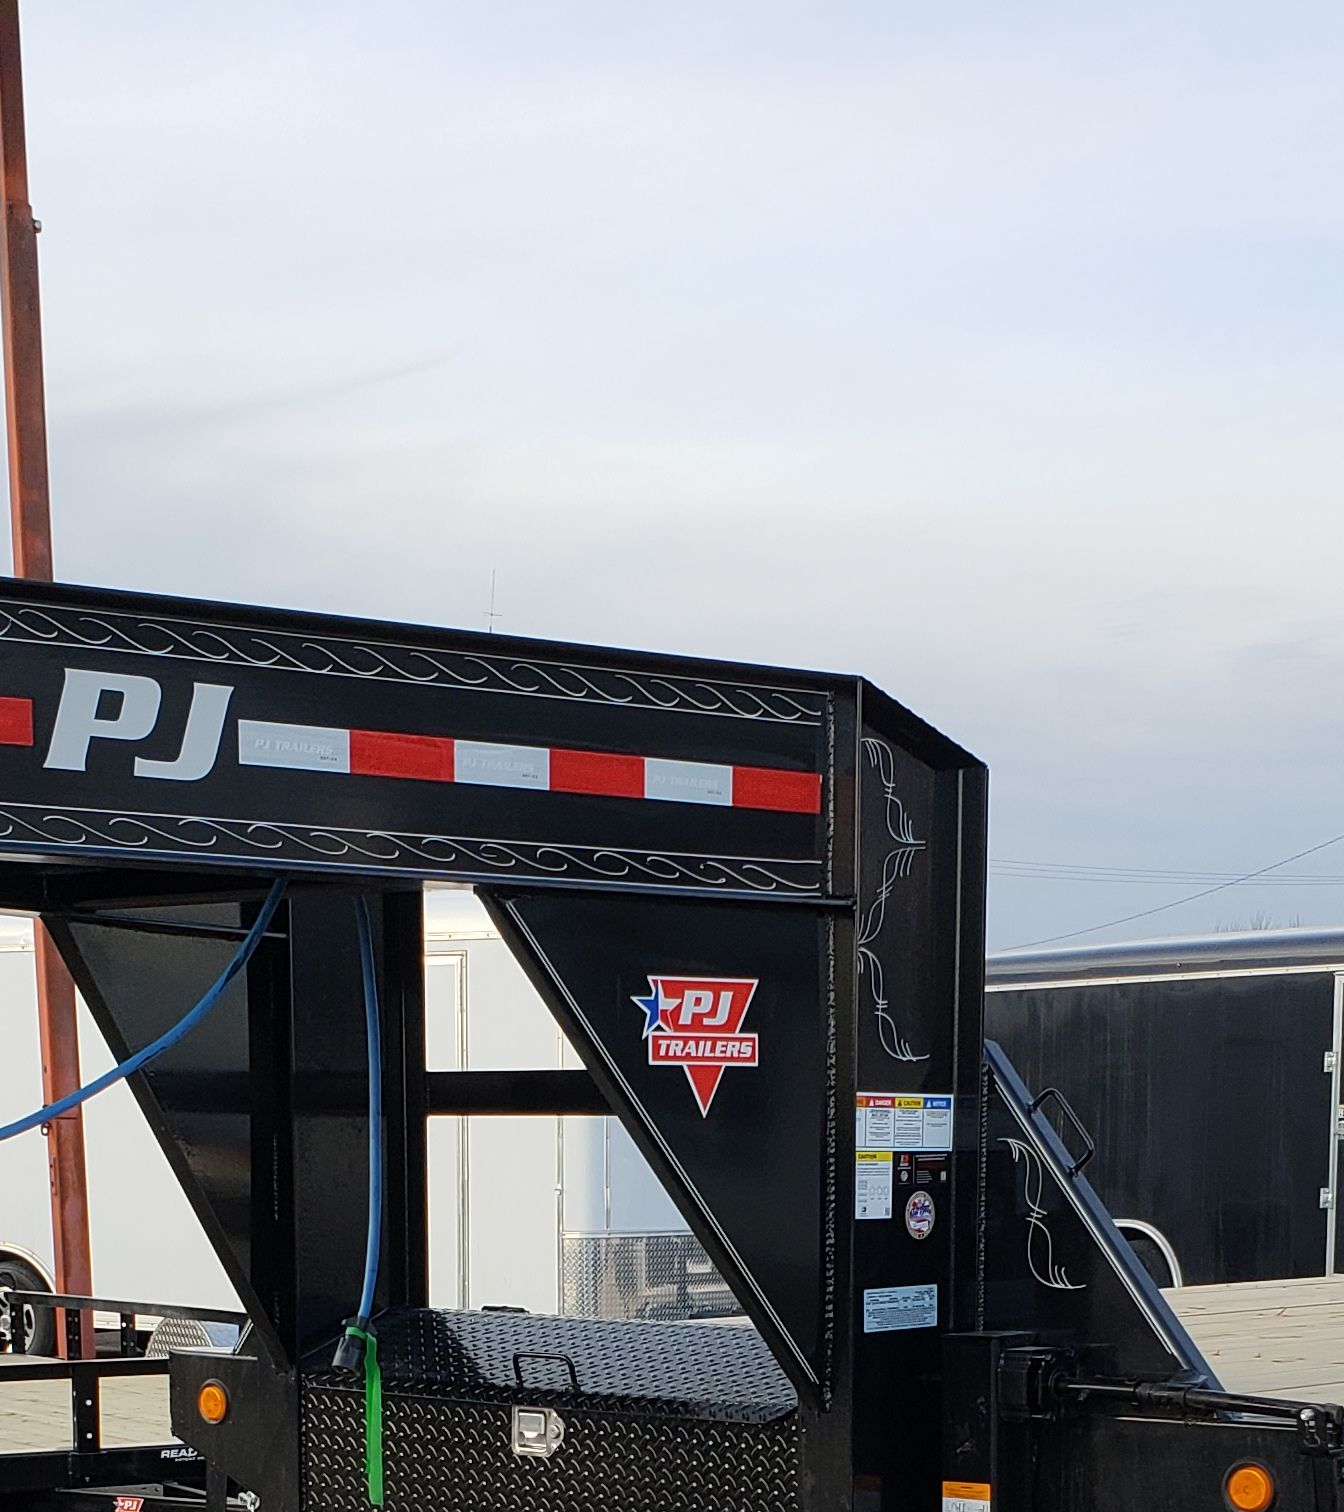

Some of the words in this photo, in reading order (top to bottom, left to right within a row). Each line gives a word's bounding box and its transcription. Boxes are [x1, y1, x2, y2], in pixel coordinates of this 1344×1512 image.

[43, 668, 234, 781] PJ
[255, 738, 272, 751] PJ
[275, 741, 334, 757] TRAILERS
[678, 990, 734, 1025] PJ
[658, 1040, 754, 1058] TRAILERS
[123, 1500, 138, 1510] PJ
